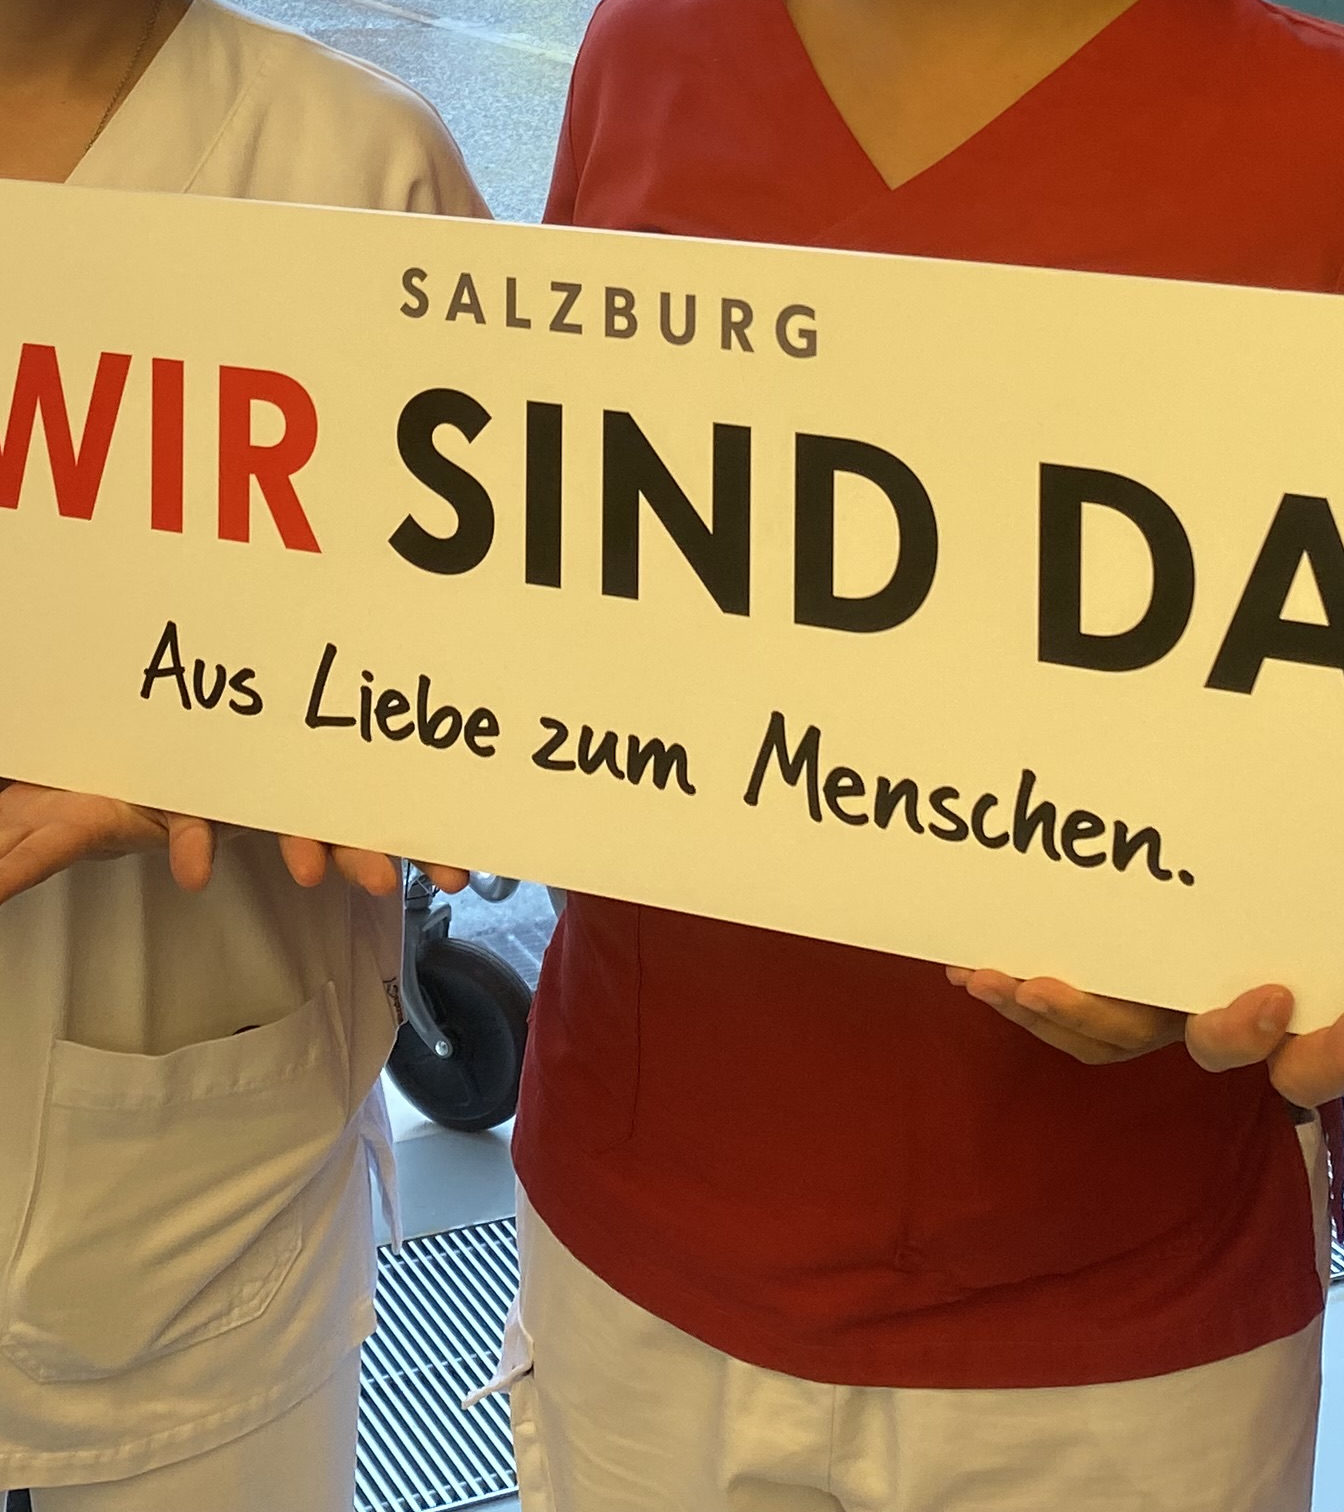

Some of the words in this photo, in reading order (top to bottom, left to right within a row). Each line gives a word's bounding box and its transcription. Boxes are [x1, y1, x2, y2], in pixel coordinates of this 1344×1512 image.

[399, 267, 818, 359] SALZBURG
[387, 387, 939, 634] SIND
[139, 620, 264, 716] Aus
[304, 642, 501, 758] Liebe
[531, 716, 697, 796] zum
[743, 710, 1196, 887] Menschen.
